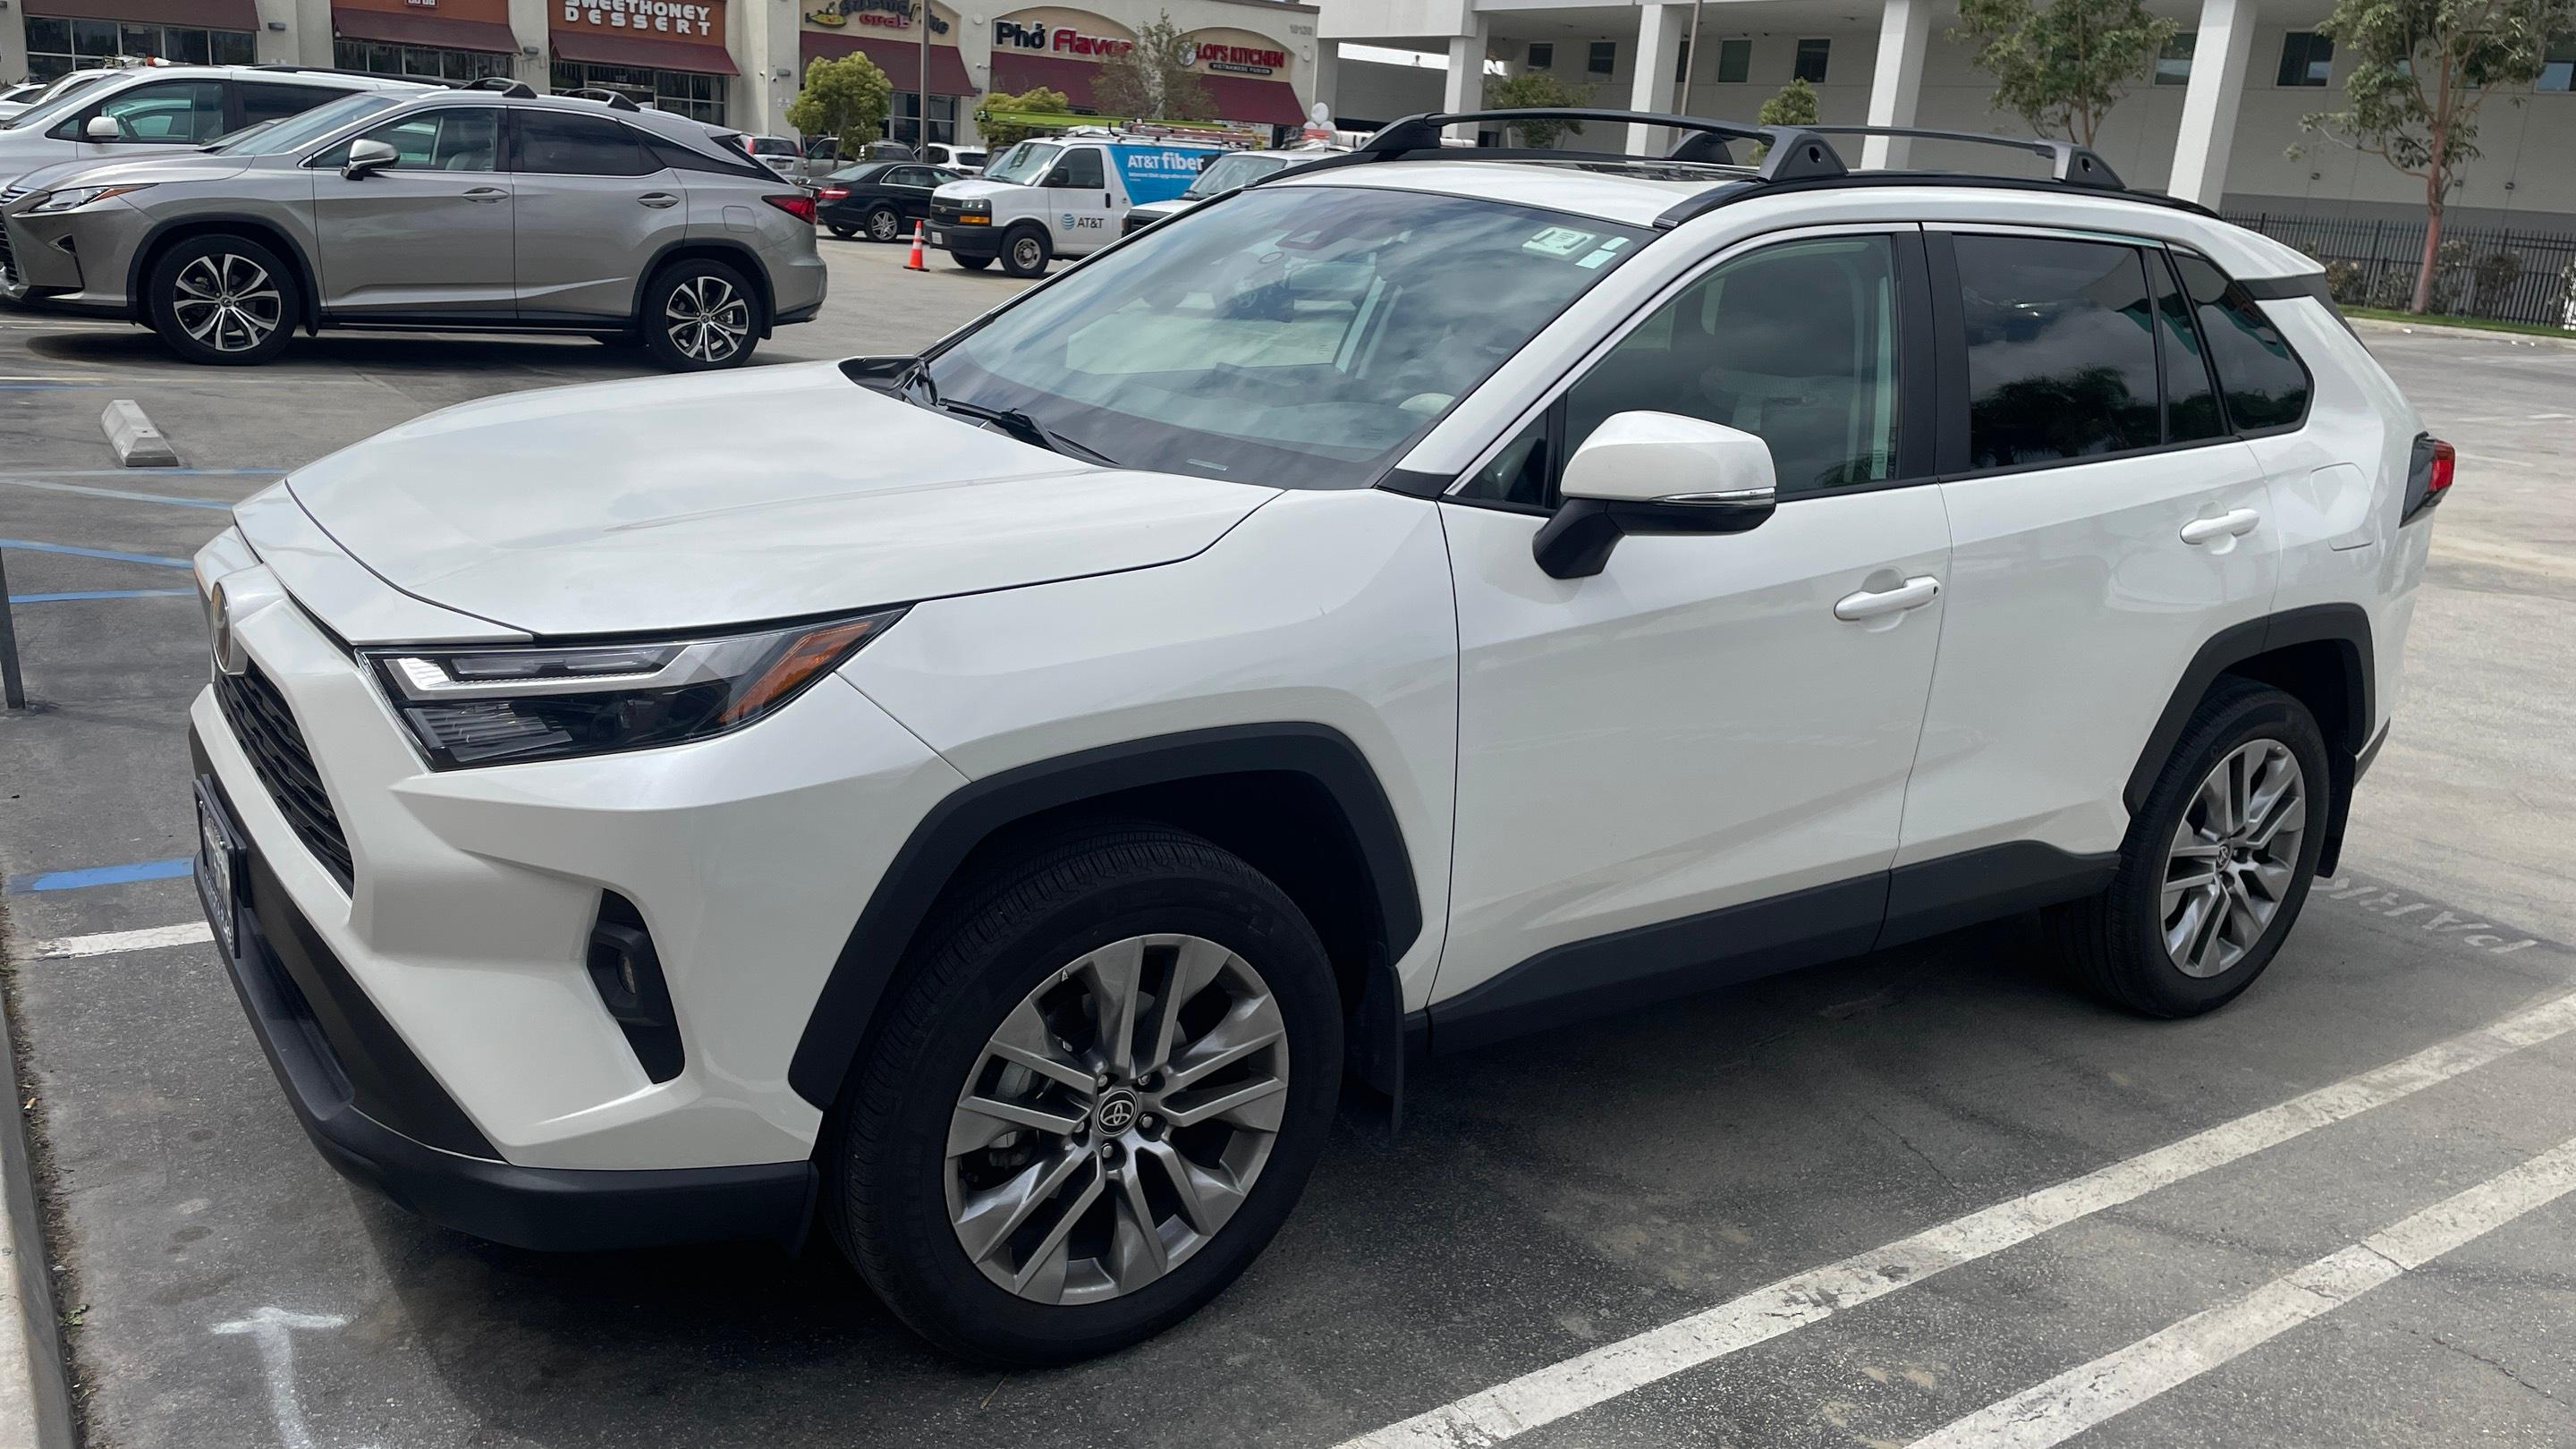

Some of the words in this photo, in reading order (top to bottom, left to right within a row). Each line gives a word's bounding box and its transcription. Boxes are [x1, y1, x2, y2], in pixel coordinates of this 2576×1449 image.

[1230, 47, 1284, 68] KITCHEN
[1127, 154, 1160, 169] AT&T
[1161, 151, 1205, 171] fiber
[1076, 216, 1105, 230] AT&T
